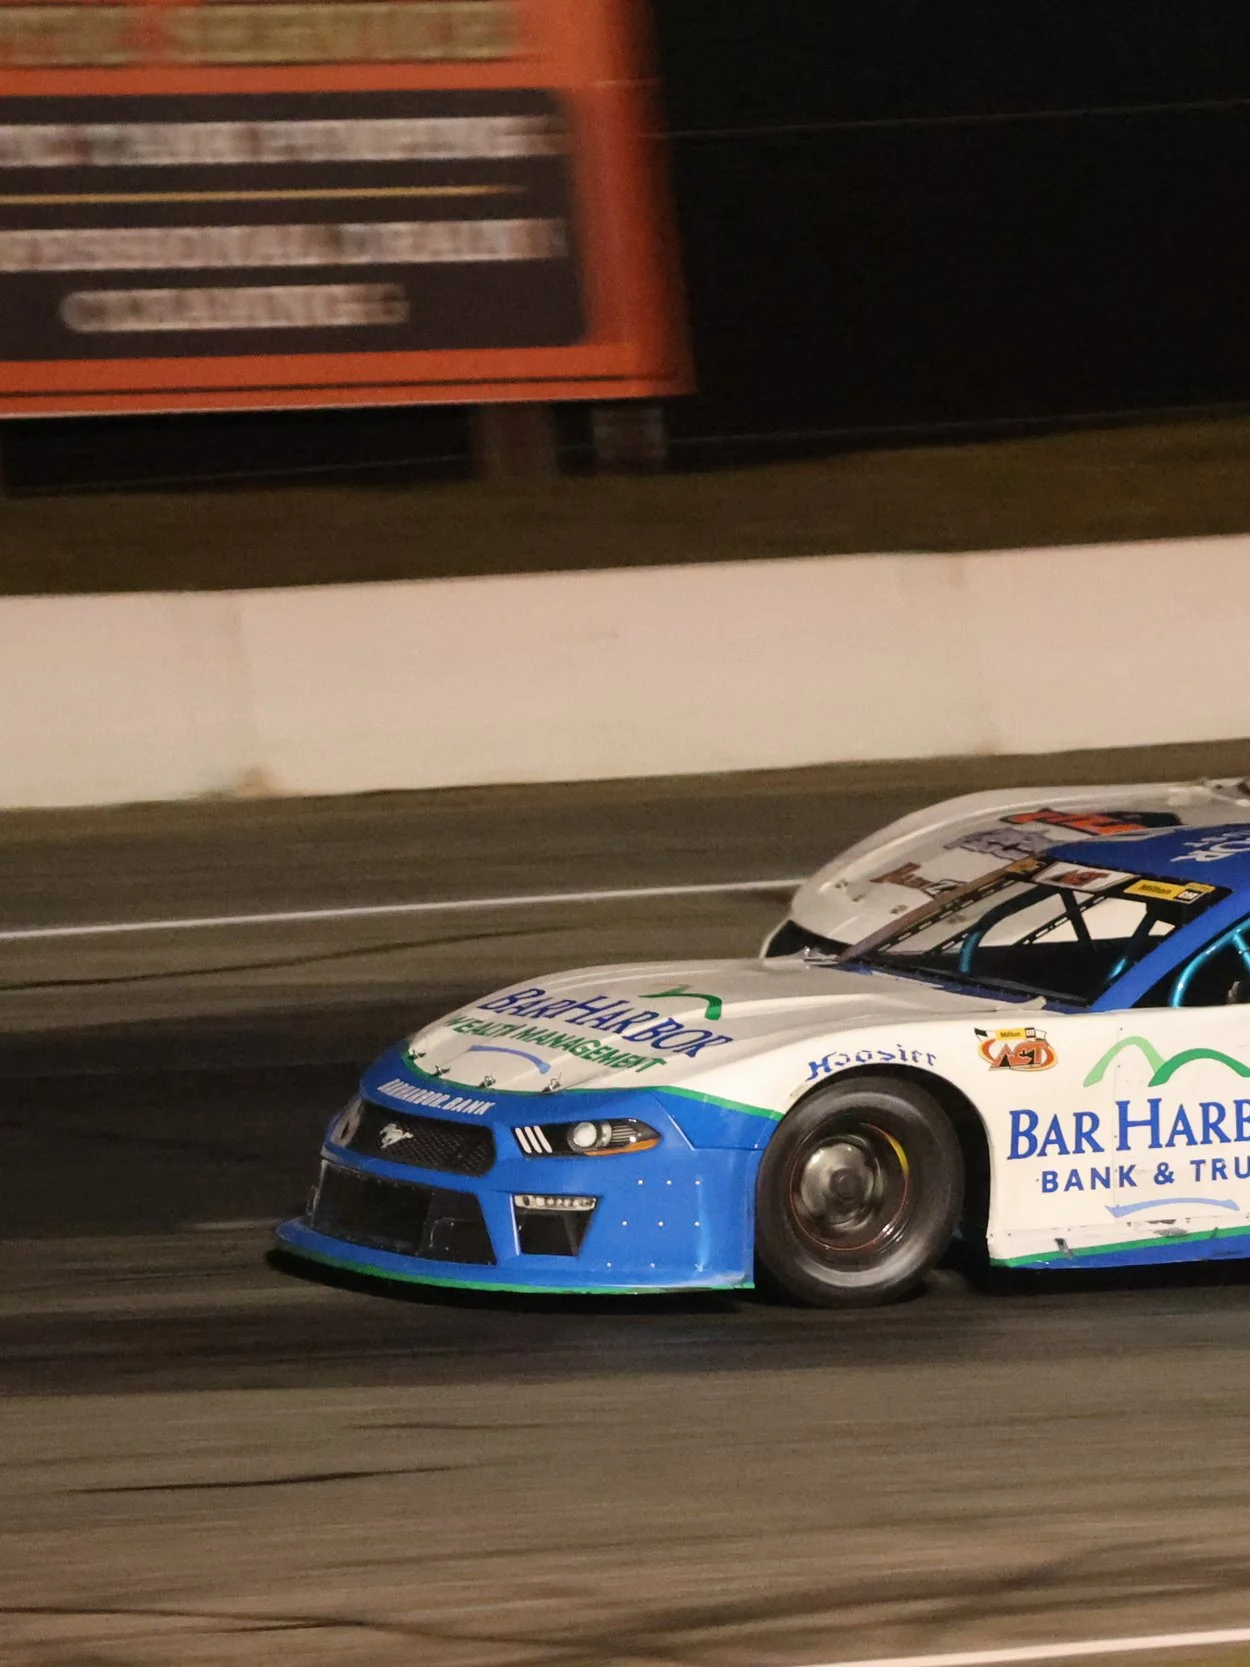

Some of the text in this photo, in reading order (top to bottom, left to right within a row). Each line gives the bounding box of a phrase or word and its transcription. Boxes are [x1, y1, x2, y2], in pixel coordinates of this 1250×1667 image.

[509, 1023, 668, 1073] MANAGEMENT
[563, 995, 734, 1058] HARBOR
[805, 1043, 937, 1081] Hoosier
[1007, 1108, 1105, 1161] BAR
[1041, 1164, 1137, 1193] BANK
[1153, 1161, 1175, 1185] &
